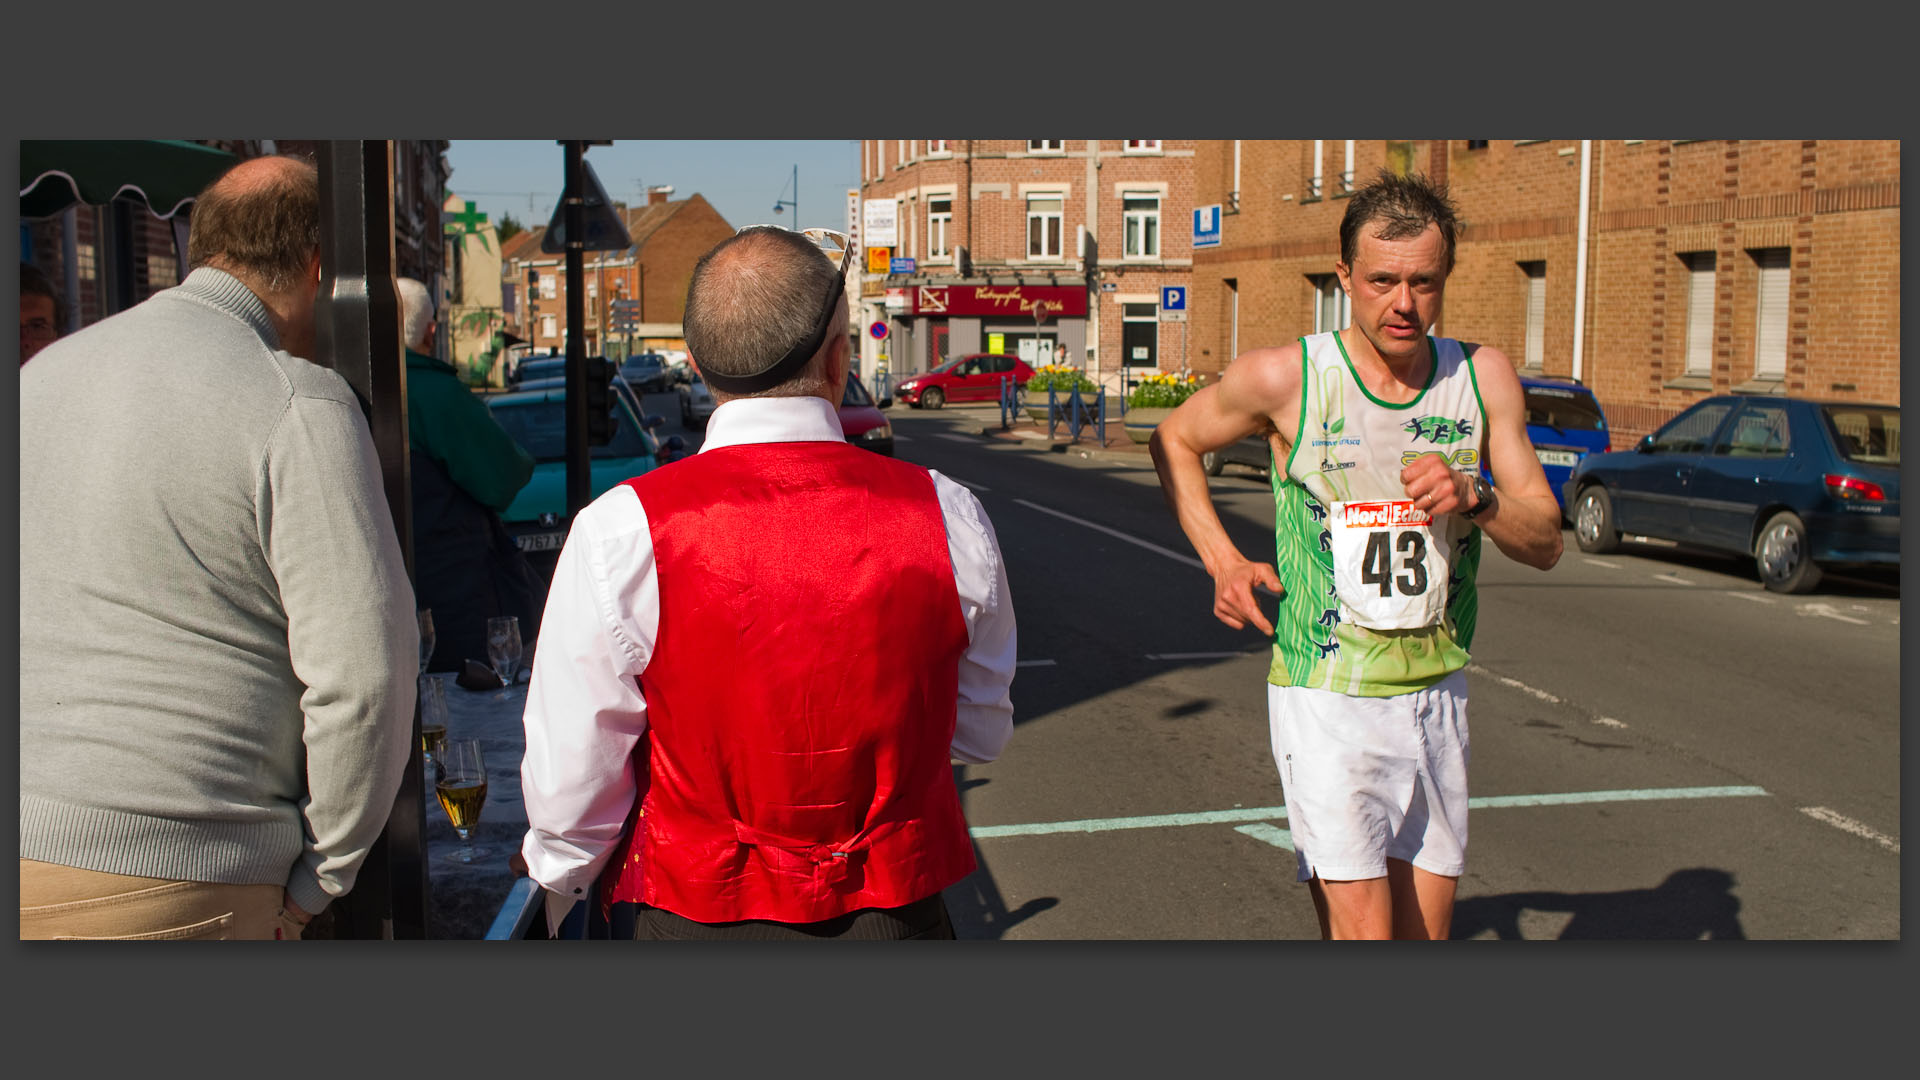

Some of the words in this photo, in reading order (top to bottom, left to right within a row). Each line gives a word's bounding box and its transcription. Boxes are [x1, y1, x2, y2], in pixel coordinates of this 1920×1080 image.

[1168, 290, 1181, 307] P
[1400, 449, 1478, 467] ava
[1346, 505, 1389, 525] Nord
[1362, 531, 1428, 597] 43
